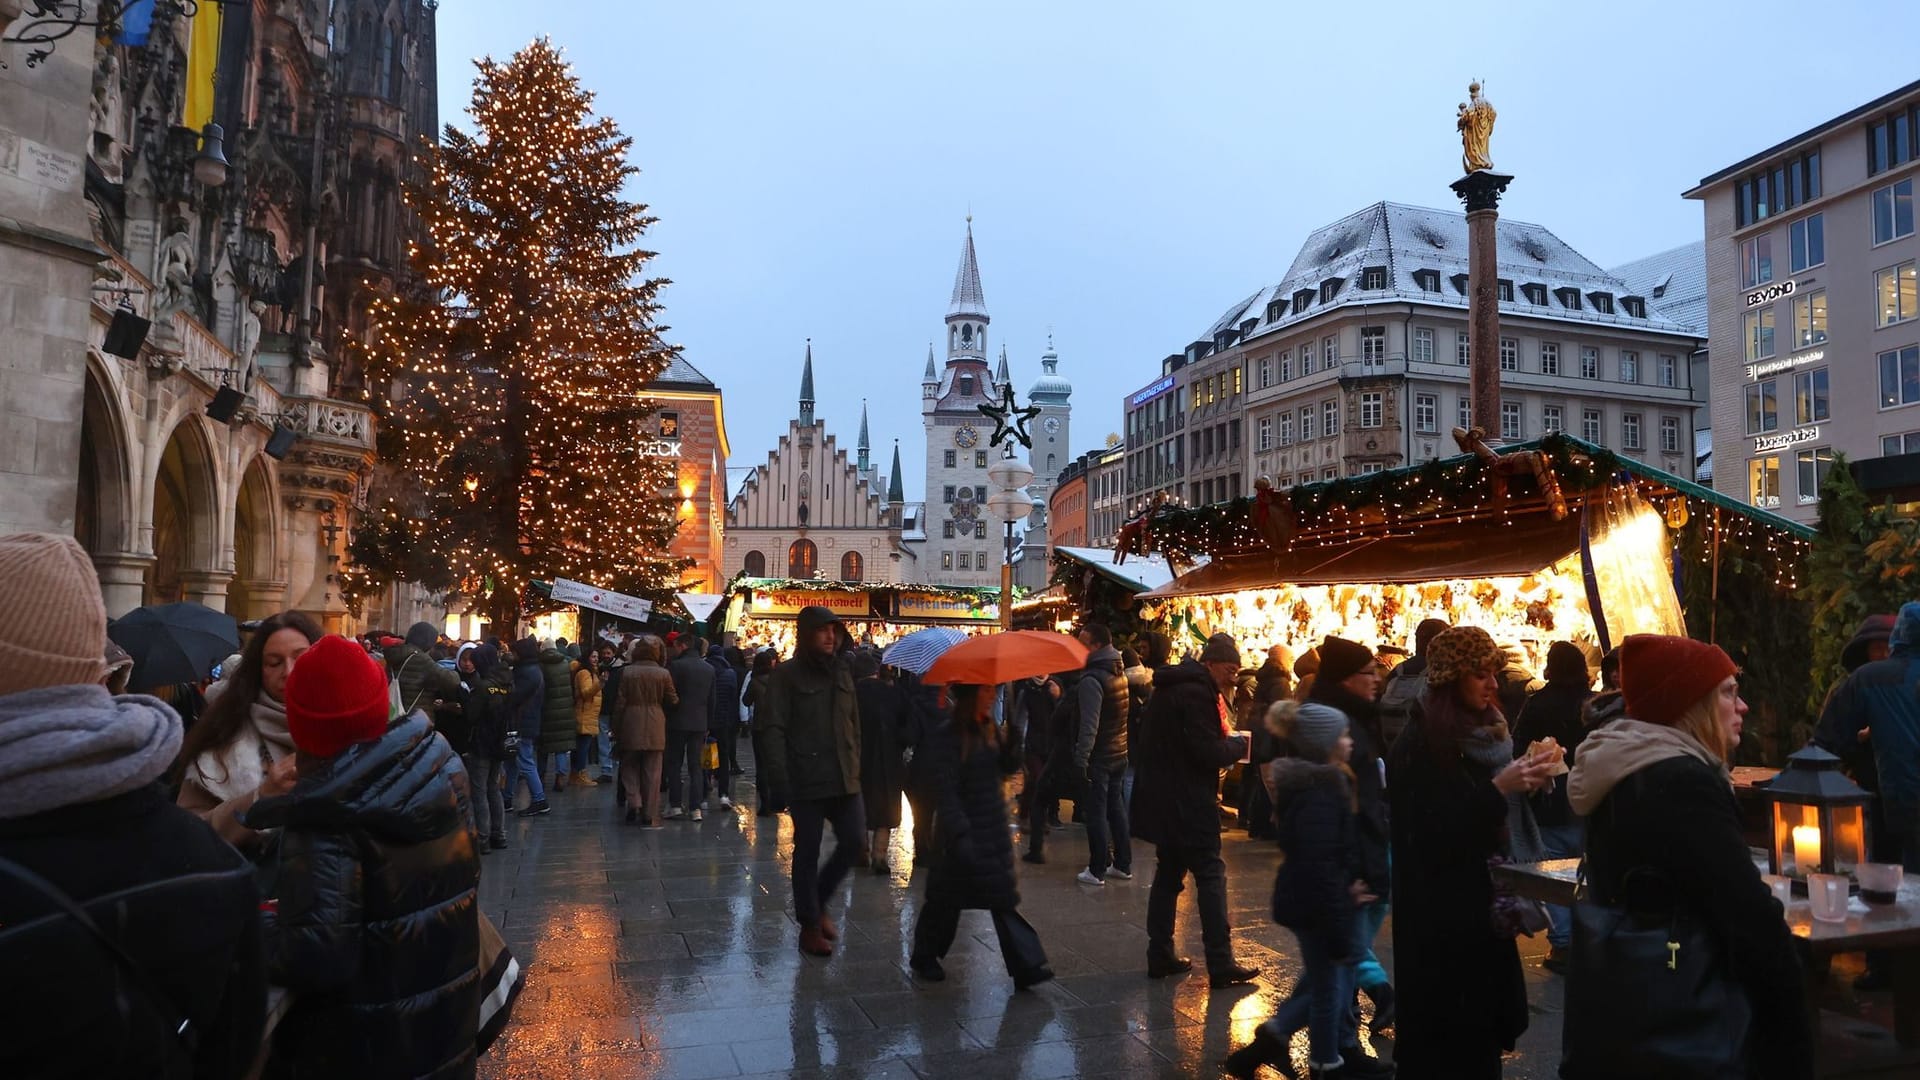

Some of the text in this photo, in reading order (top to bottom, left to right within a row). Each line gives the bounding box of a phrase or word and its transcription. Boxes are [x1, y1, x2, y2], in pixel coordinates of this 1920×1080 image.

[1747, 281, 1795, 307] BEYOND
[1754, 427, 1818, 450] Hugendubel
[773, 592, 863, 609] Weihnachtswelt
